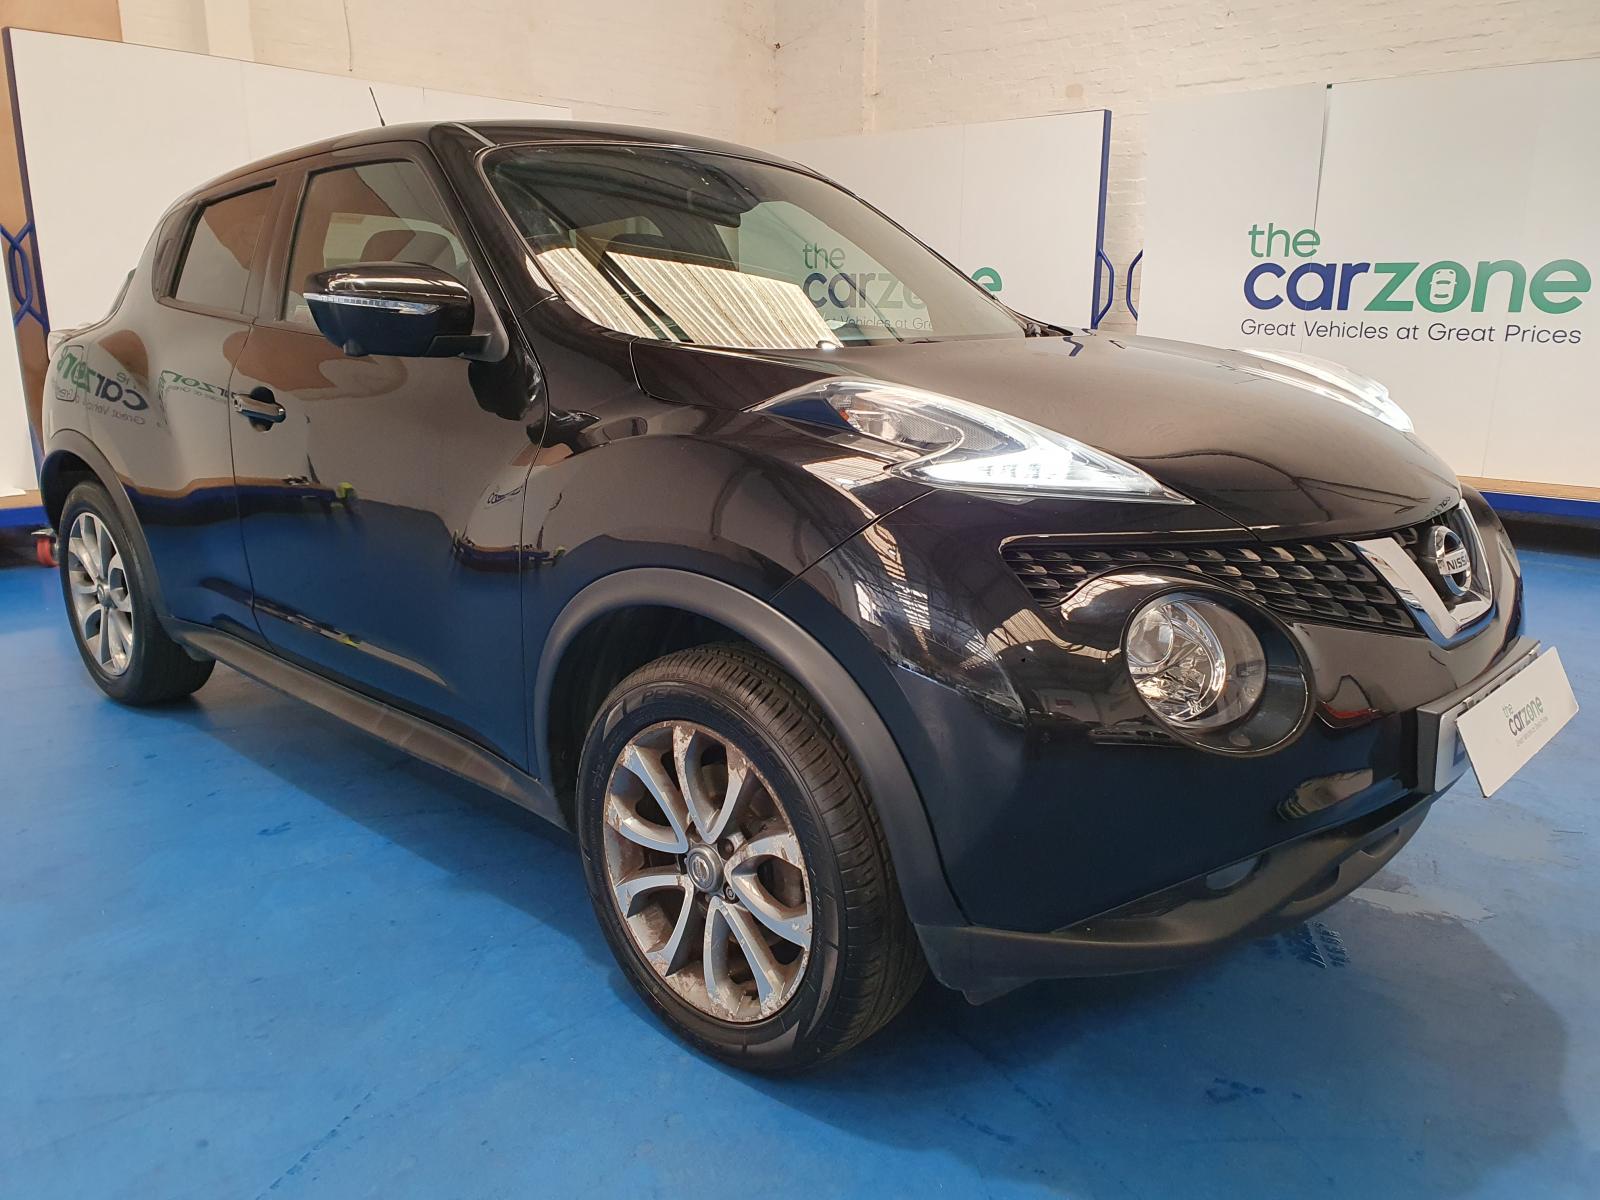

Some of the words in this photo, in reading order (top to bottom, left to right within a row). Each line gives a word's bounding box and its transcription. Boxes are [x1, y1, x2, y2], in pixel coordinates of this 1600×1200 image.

[803, 243, 846, 269] the
[1248, 222, 1321, 258] the
[1243, 258, 1592, 314] carzone
[1240, 318, 1296, 337] Great
[1304, 320, 1389, 340] Vehicles
[1396, 324, 1419, 341] at
[1427, 322, 1496, 342] Great
[1504, 324, 1582, 344] Prices
[1508, 696, 1544, 736] carzone
